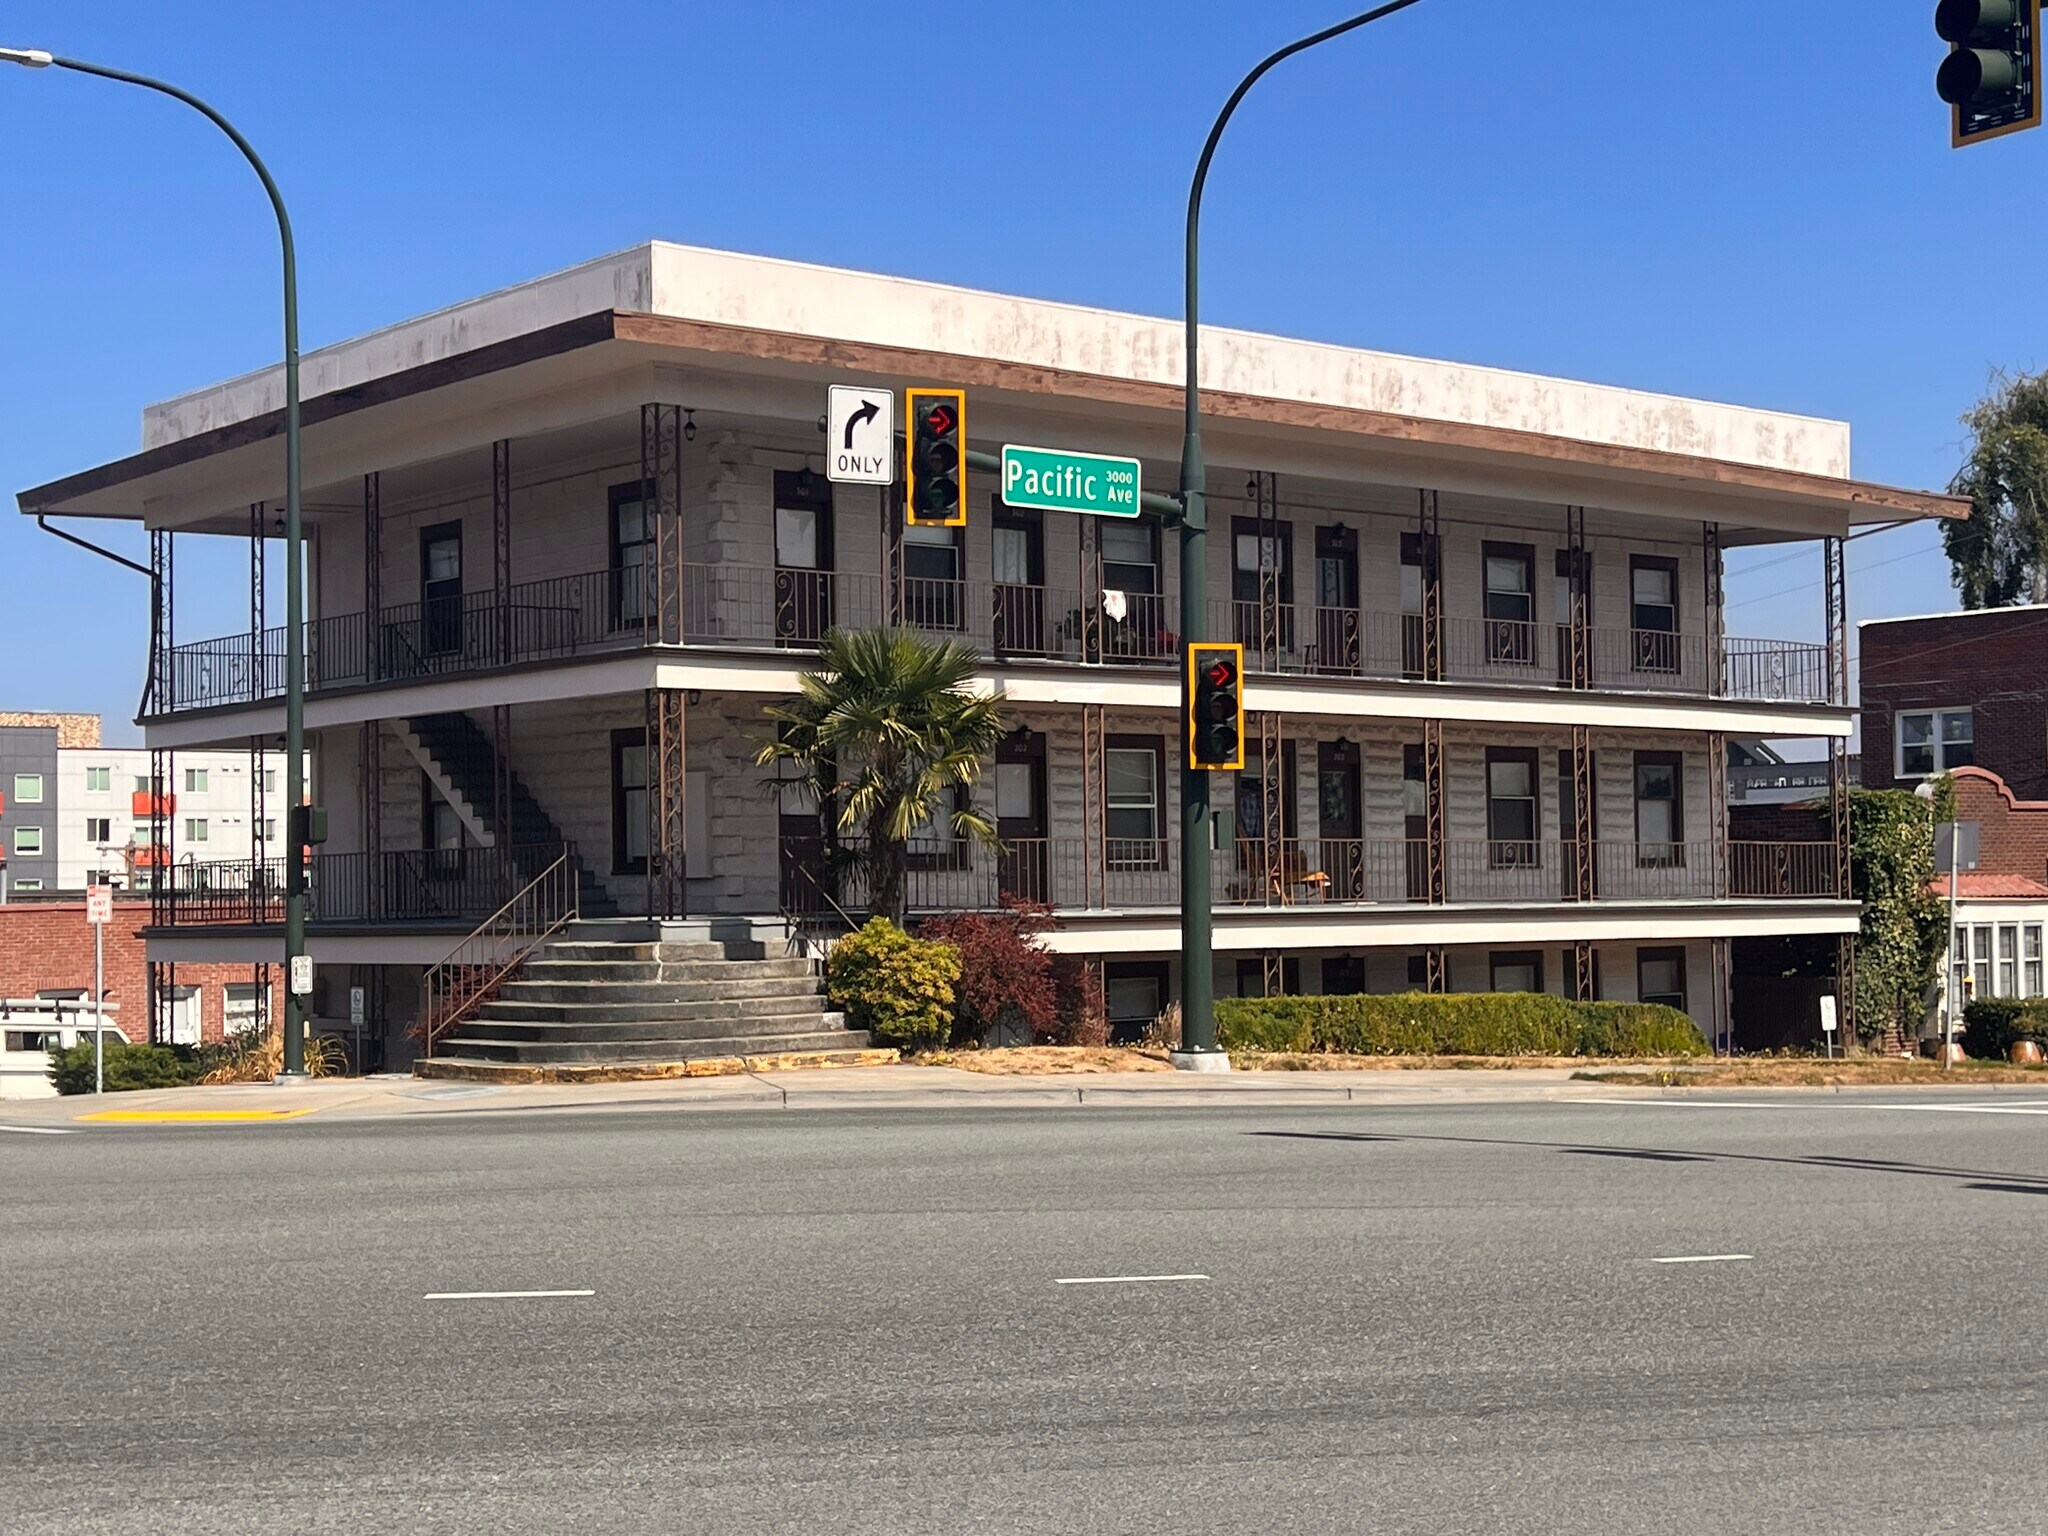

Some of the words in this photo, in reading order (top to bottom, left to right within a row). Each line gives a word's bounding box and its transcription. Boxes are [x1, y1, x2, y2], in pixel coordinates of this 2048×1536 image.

[838, 455, 883, 474] ONLY
[1007, 459, 1097, 501] Pacific
[1106, 470, 1133, 484] 3000
[1107, 485, 1133, 504] Ave
